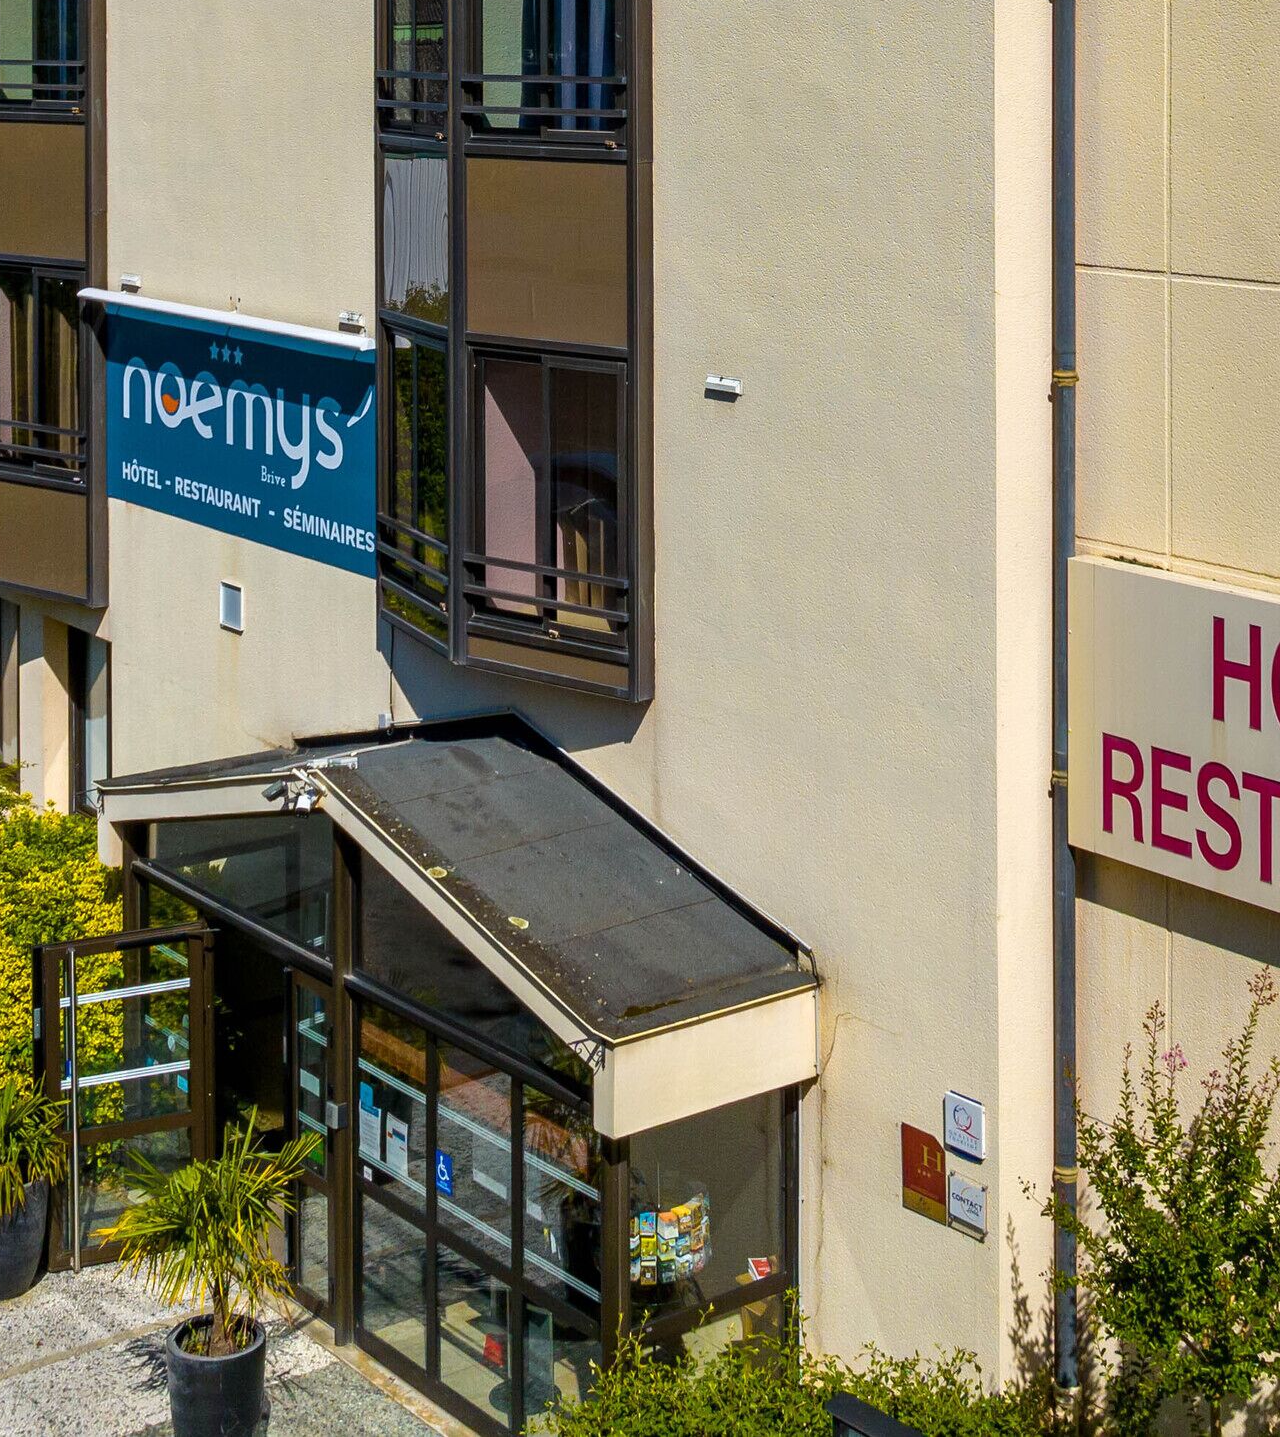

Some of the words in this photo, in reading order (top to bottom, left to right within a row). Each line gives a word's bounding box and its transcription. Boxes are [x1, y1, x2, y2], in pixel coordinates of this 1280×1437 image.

[260, 465, 286, 488] Brive
[122, 458, 162, 490] HÔTEL
[175, 476, 261, 519] RESTAURANT
[283, 505, 375, 553] SÉMINAIRES
[922, 1145, 942, 1173] H
[951, 1192, 983, 1212] CONTACT
